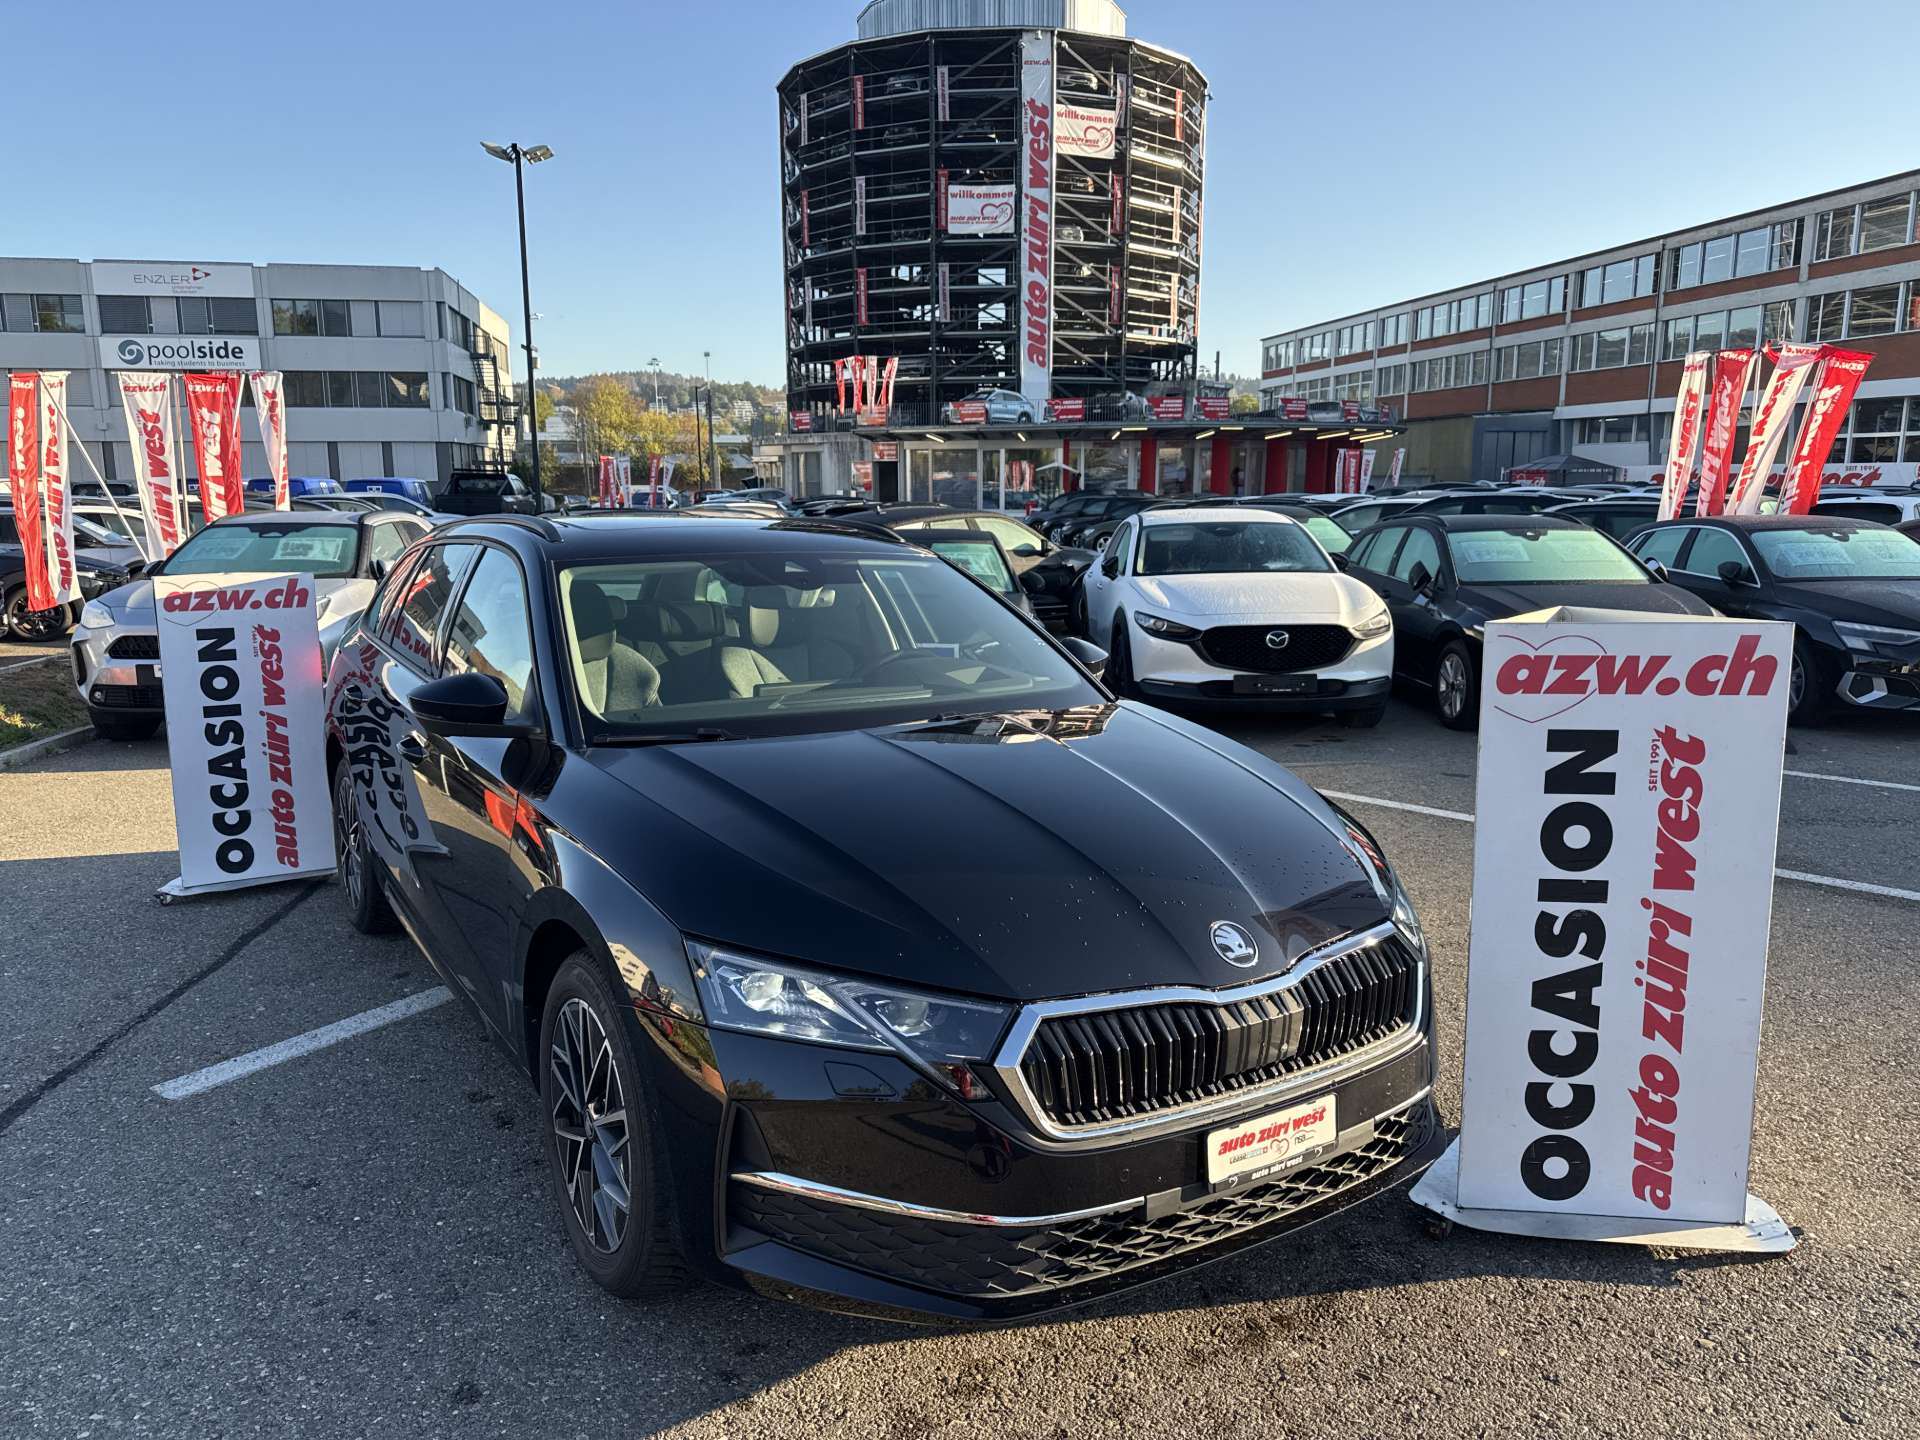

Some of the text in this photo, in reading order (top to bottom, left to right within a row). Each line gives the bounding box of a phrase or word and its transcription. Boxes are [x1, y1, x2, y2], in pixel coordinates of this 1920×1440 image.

[1056, 109, 1114, 124] willkommen
[950, 190, 1013, 199] willkommen
[1023, 97, 1050, 369] auto züri west
[133, 274, 191, 285] ENZLER
[147, 340, 244, 366] poolside
[123, 382, 167, 392] azw.ch
[137, 405, 170, 478] west
[198, 406, 224, 477] west
[163, 578, 309, 613] azw.ch
[1496, 634, 1778, 696] azw.ch
[196, 627, 254, 874] OCCASION
[256, 624, 299, 868] auto züri west
[1648, 736, 1661, 792] SEIT 1991
[1520, 729, 1619, 1201] OCCASION
[1627, 724, 1706, 1211] auto züri west
[1218, 1132, 1256, 1156] auto
[1257, 1117, 1291, 1143] züri
[1293, 1105, 1327, 1131] west
[1252, 1168, 1269, 1180] auto
[1287, 1155, 1303, 1167] west
